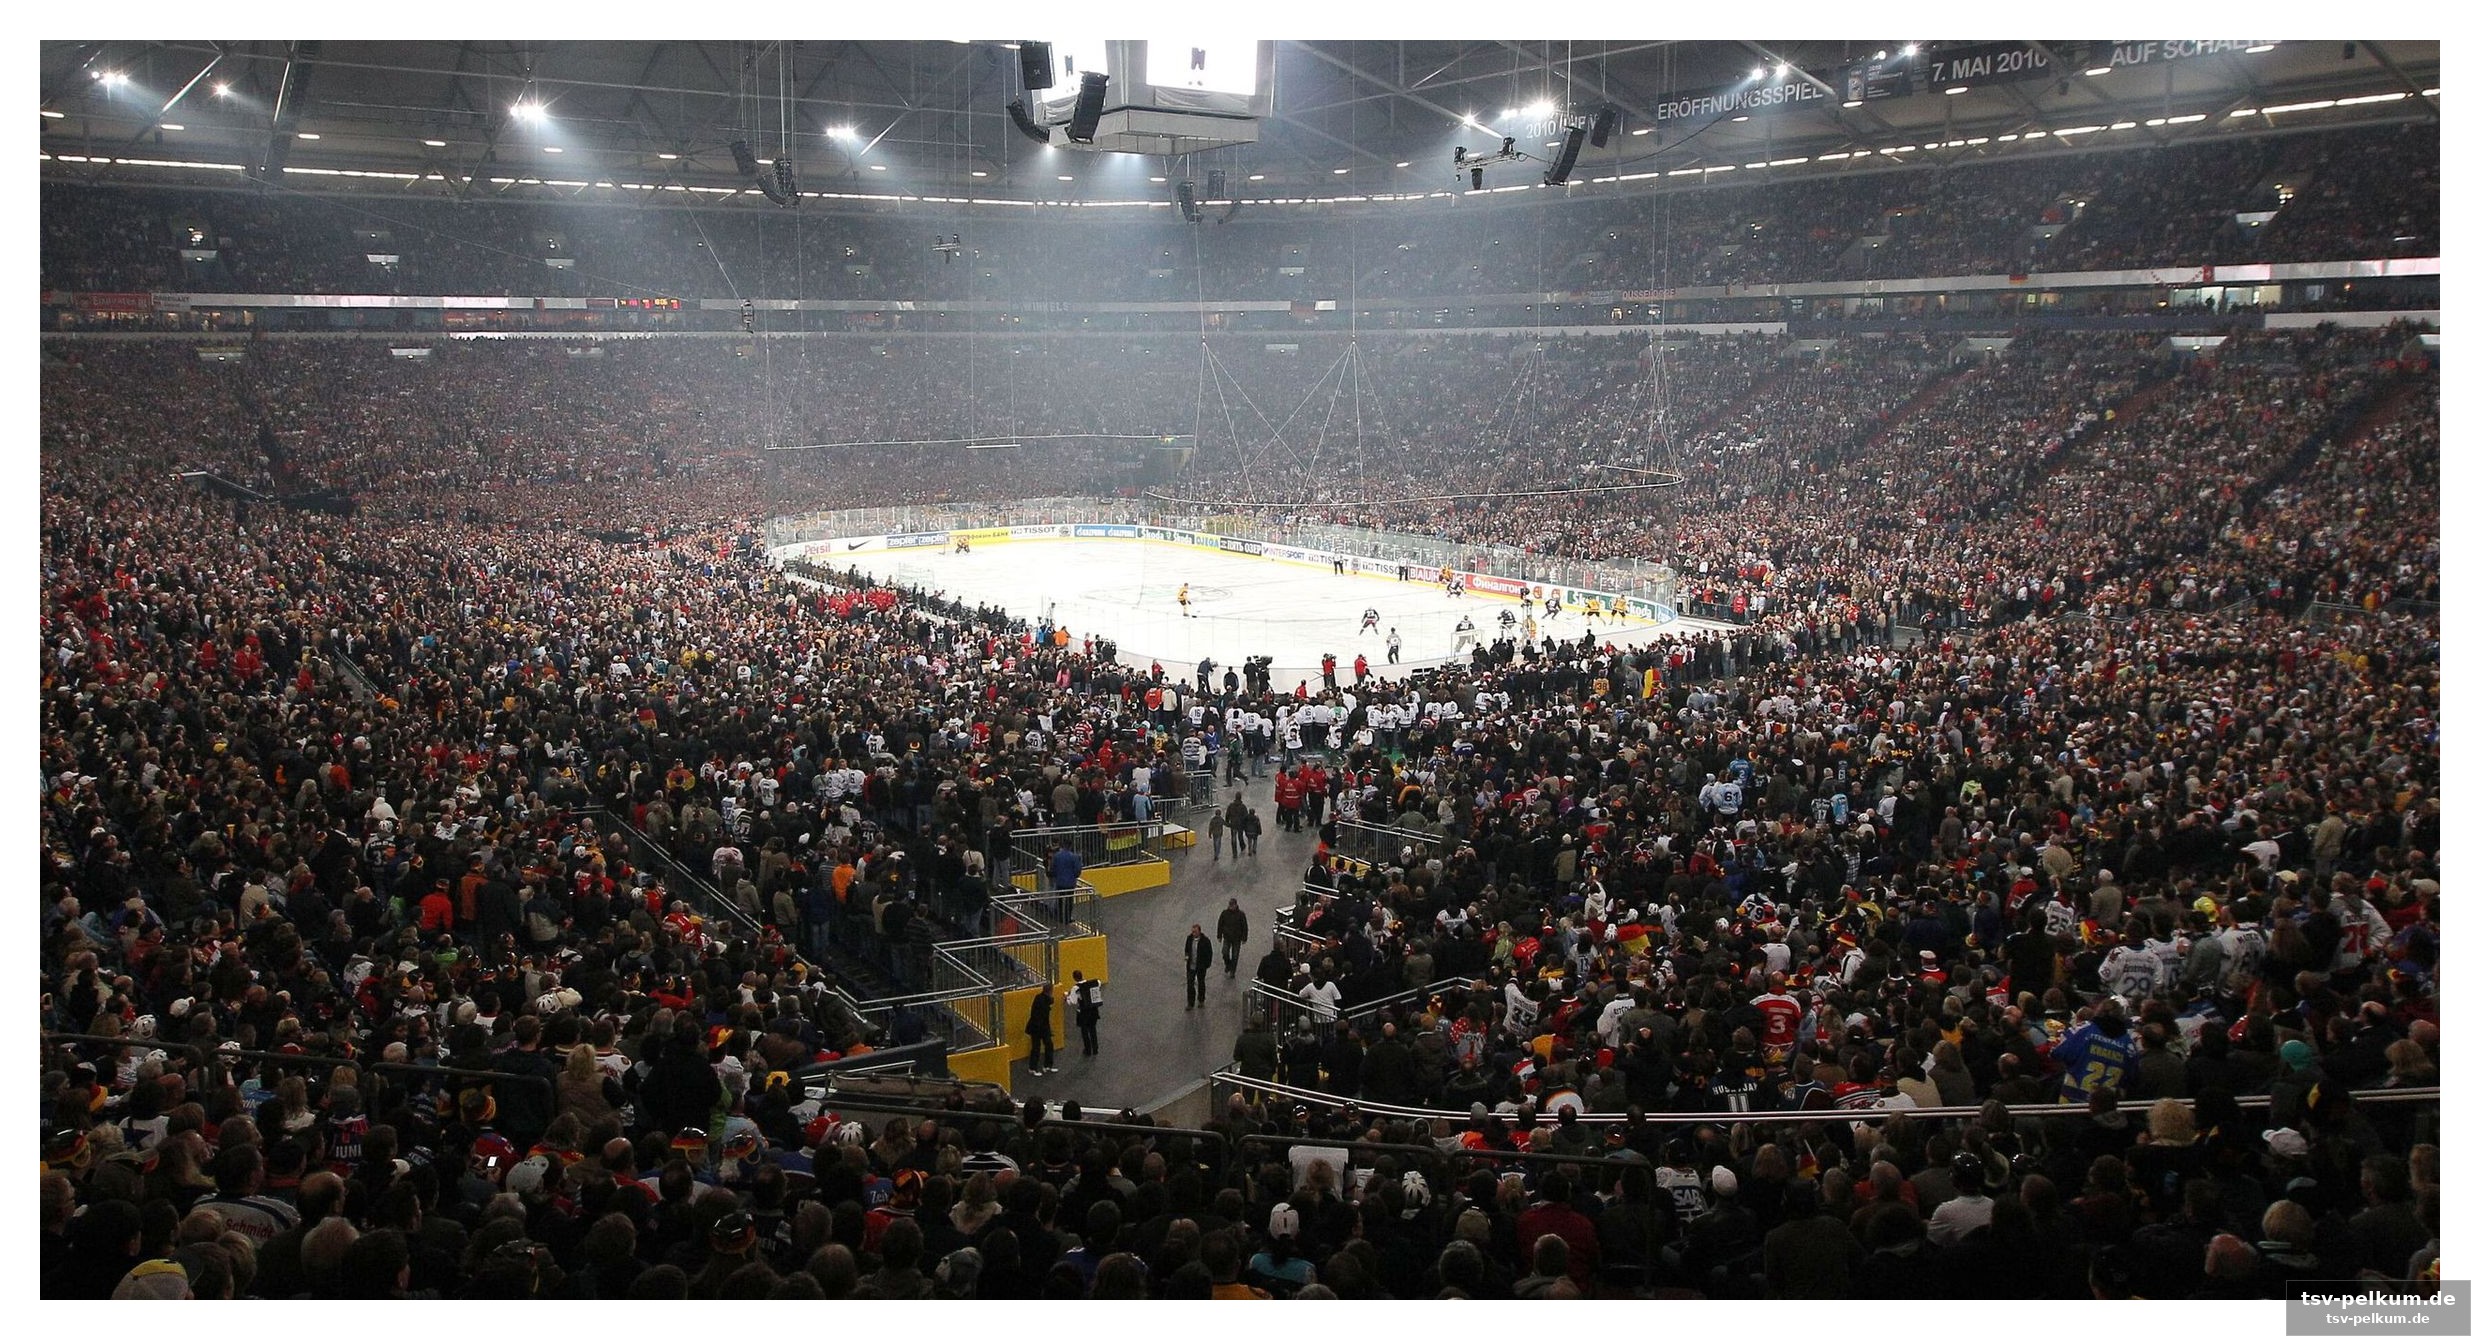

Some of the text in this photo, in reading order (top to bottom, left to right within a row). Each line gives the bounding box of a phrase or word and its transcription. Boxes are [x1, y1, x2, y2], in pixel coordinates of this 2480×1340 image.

[2110, 40, 2282, 67] AUF SCHA
[1931, 50, 2047, 83] 7. MAI 2010
[1657, 82, 1824, 121] ERÖFFNUNGSSPIEL
[1525, 120, 1556, 139] 2010
[1024, 526, 1056, 534] TISSOT
[804, 542, 831, 556] Persil
[1267, 546, 1305, 561] INTERSPORT
[1320, 555, 1349, 567] TIST
[1409, 567, 1464, 586] BAUHS
[1343, 801, 1356, 812] 22
[1770, 1014, 1786, 1034] 3
[2081, 1060, 2126, 1095] 22
[1727, 1092, 1749, 1112] 11
[1672, 1188, 1700, 1207] SAP
[226, 1218, 274, 1239] Schmidt
